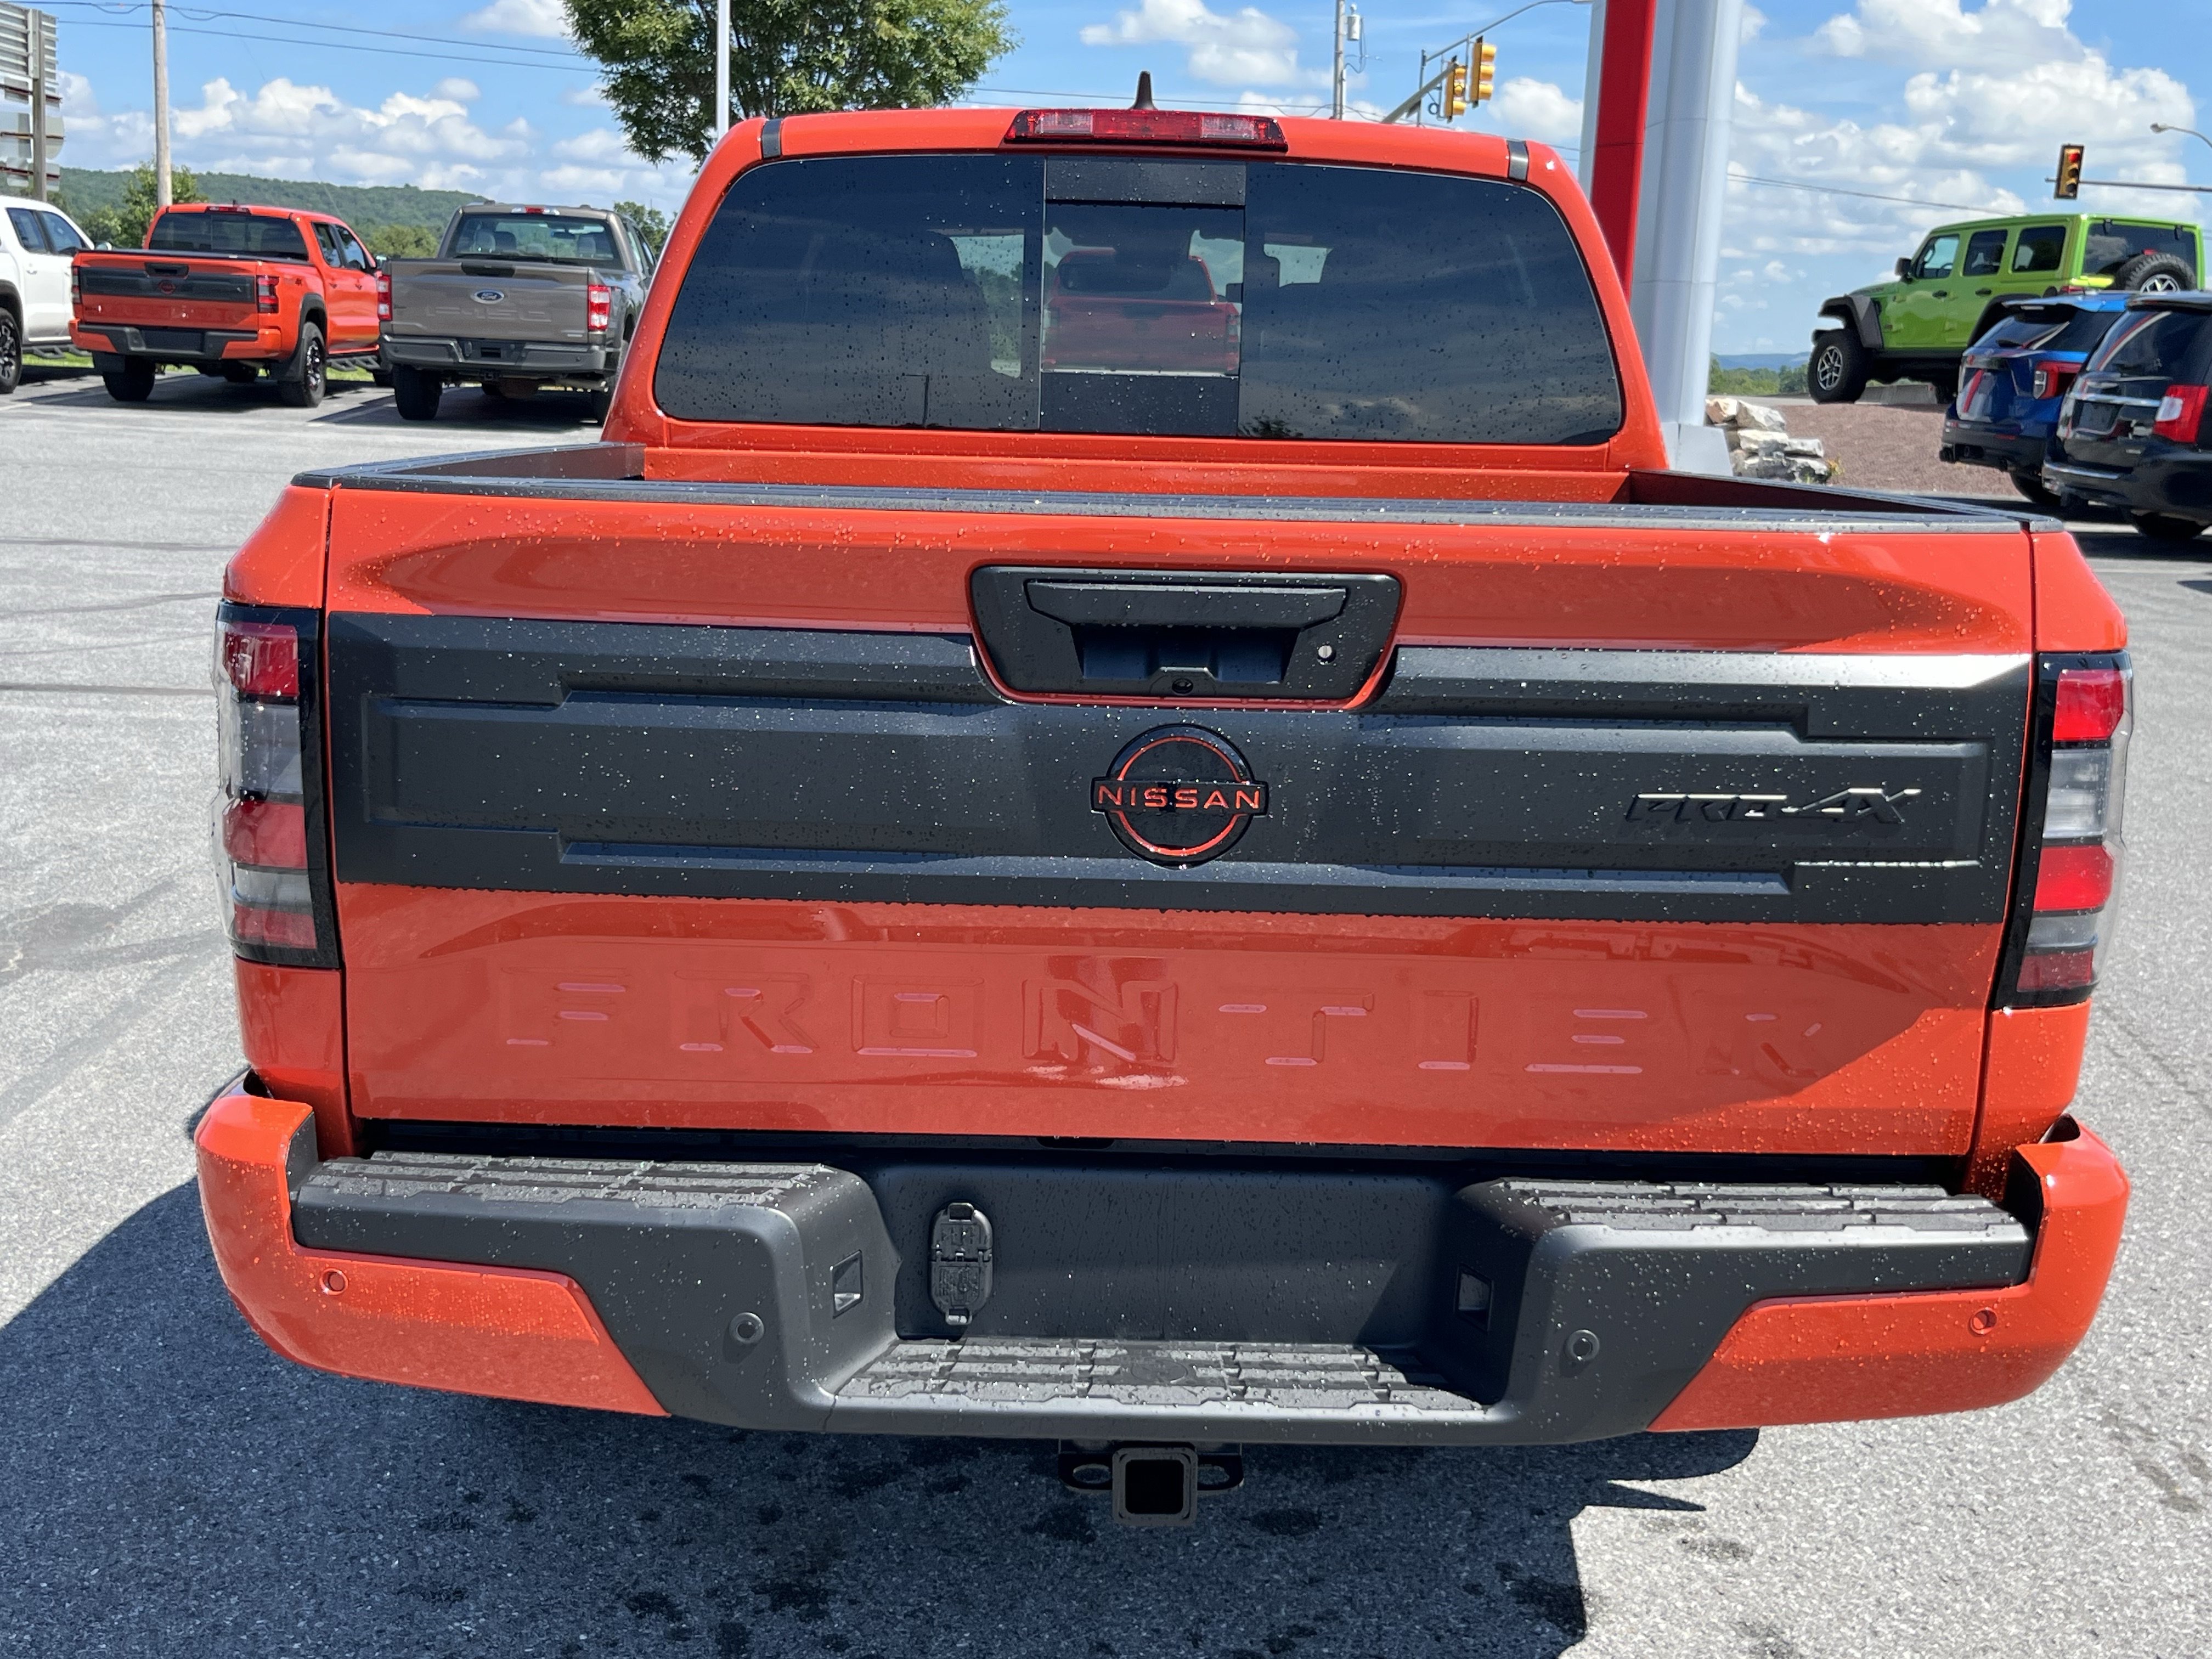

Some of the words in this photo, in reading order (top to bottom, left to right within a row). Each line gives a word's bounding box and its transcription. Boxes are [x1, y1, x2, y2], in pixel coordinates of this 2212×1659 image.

[1098, 785, 1260, 809] NISSAN
[1625, 787, 1921, 823] PRO-4X
[499, 967, 1824, 1076] FRONTIER
